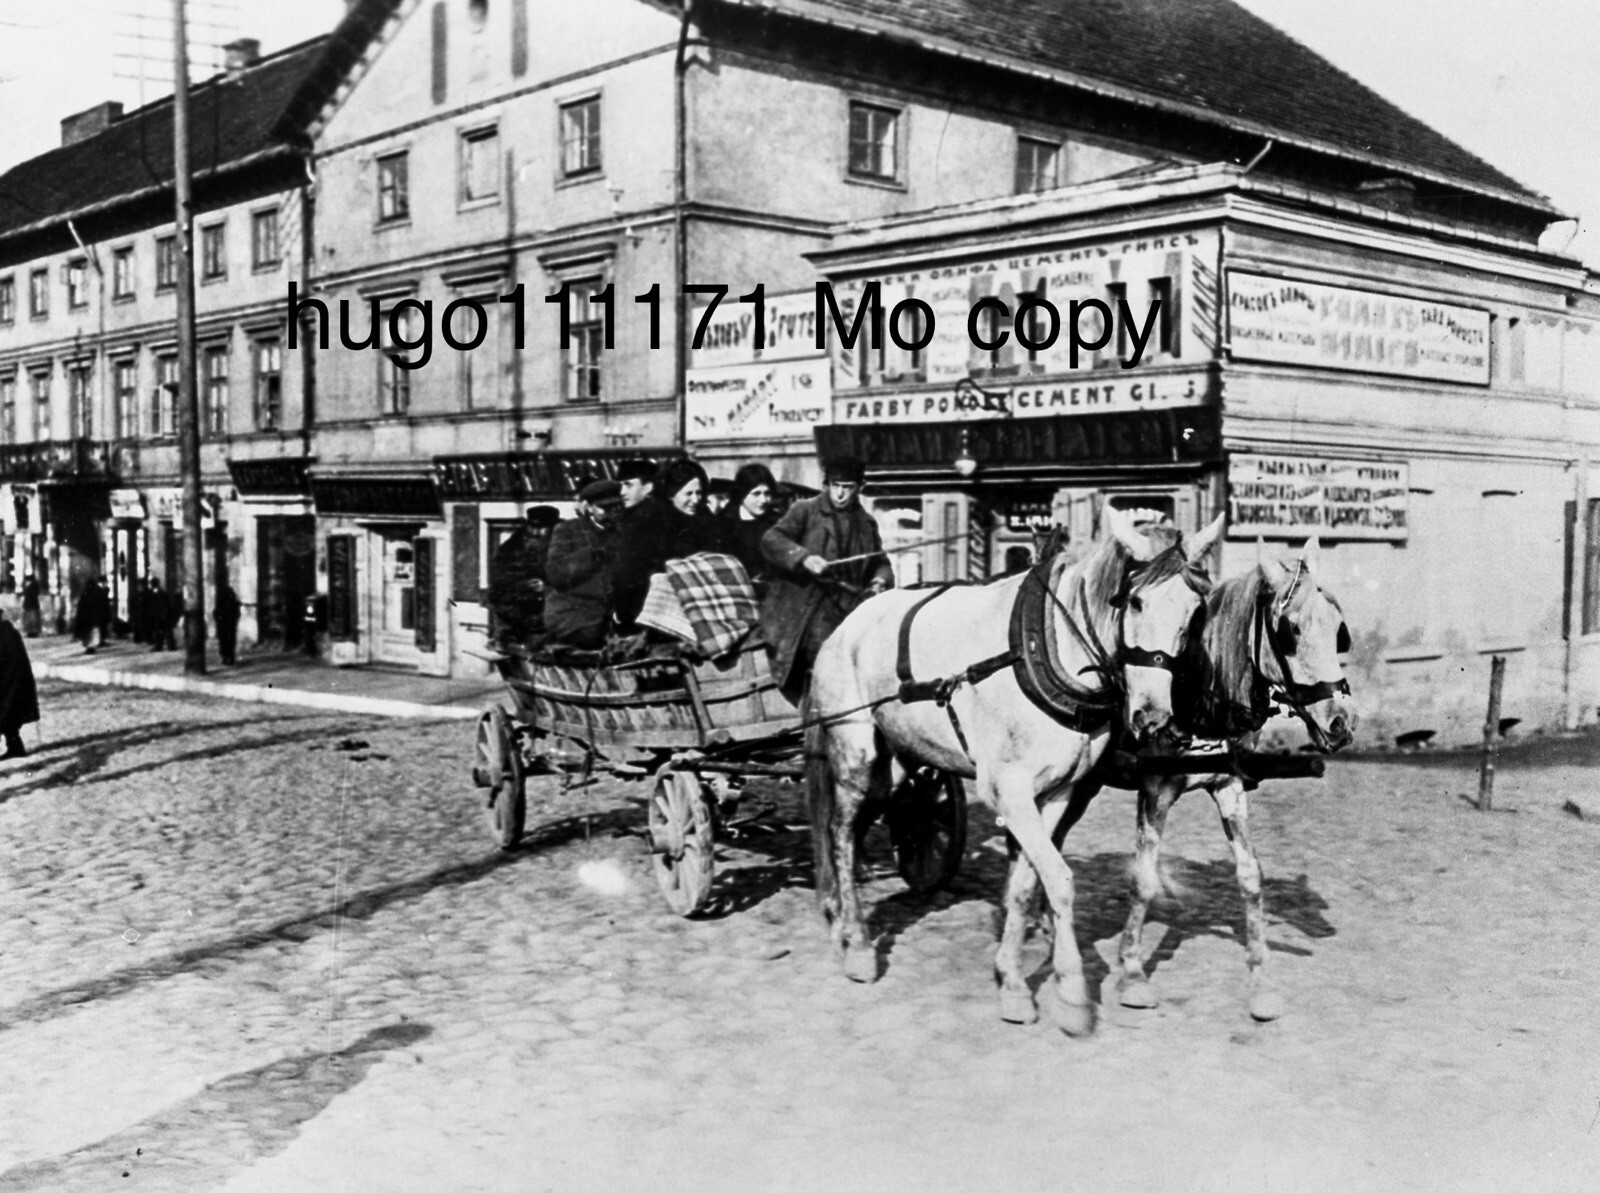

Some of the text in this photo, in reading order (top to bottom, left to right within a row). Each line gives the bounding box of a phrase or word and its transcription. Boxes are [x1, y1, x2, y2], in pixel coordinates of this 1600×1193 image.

[1008, 247, 1109, 270] ЦЕМЕНТЪ
[1121, 234, 1199, 255] ГИПСЪ
[846, 398, 913, 419] FARBY
[1017, 385, 1115, 408] CEMENT
